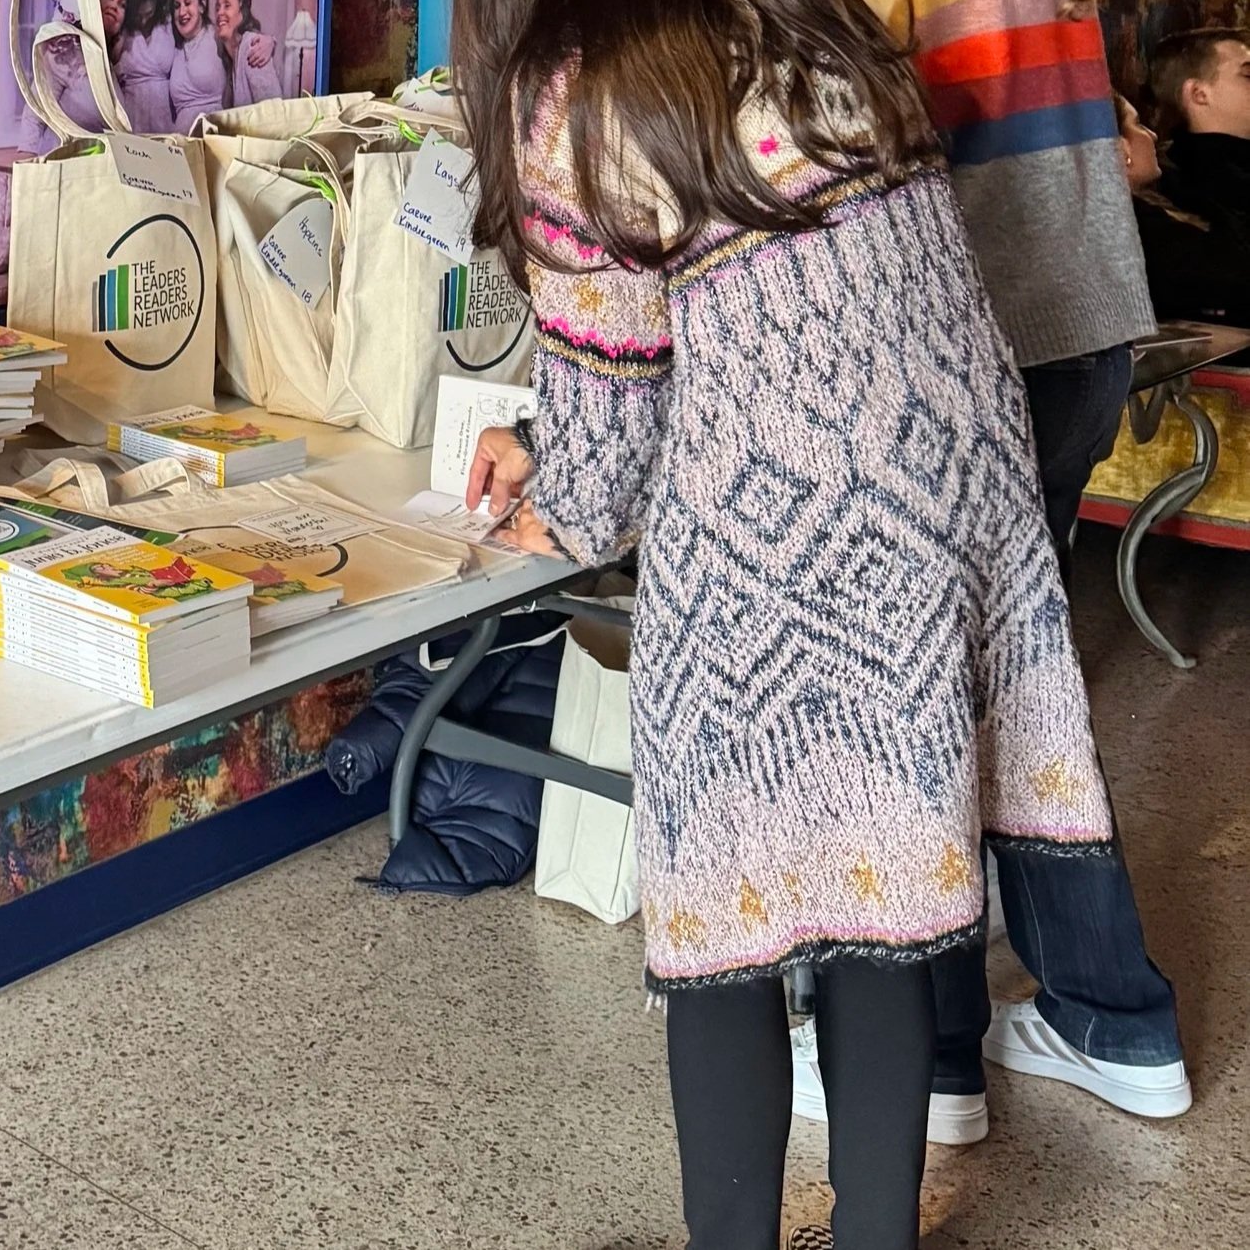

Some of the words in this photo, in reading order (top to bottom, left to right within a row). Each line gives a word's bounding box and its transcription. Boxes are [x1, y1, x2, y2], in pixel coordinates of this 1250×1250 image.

[455, 235, 467, 252] 19
[131, 260, 156, 277] THE
[469, 260, 491, 275] THE
[134, 267, 186, 293] LEADERS
[134, 284, 188, 312] READERS
[301, 289, 312, 304] 18
[468, 290, 517, 311] READERS
[133, 300, 195, 329] NETWORK
[466, 306, 522, 329] NETWORK
